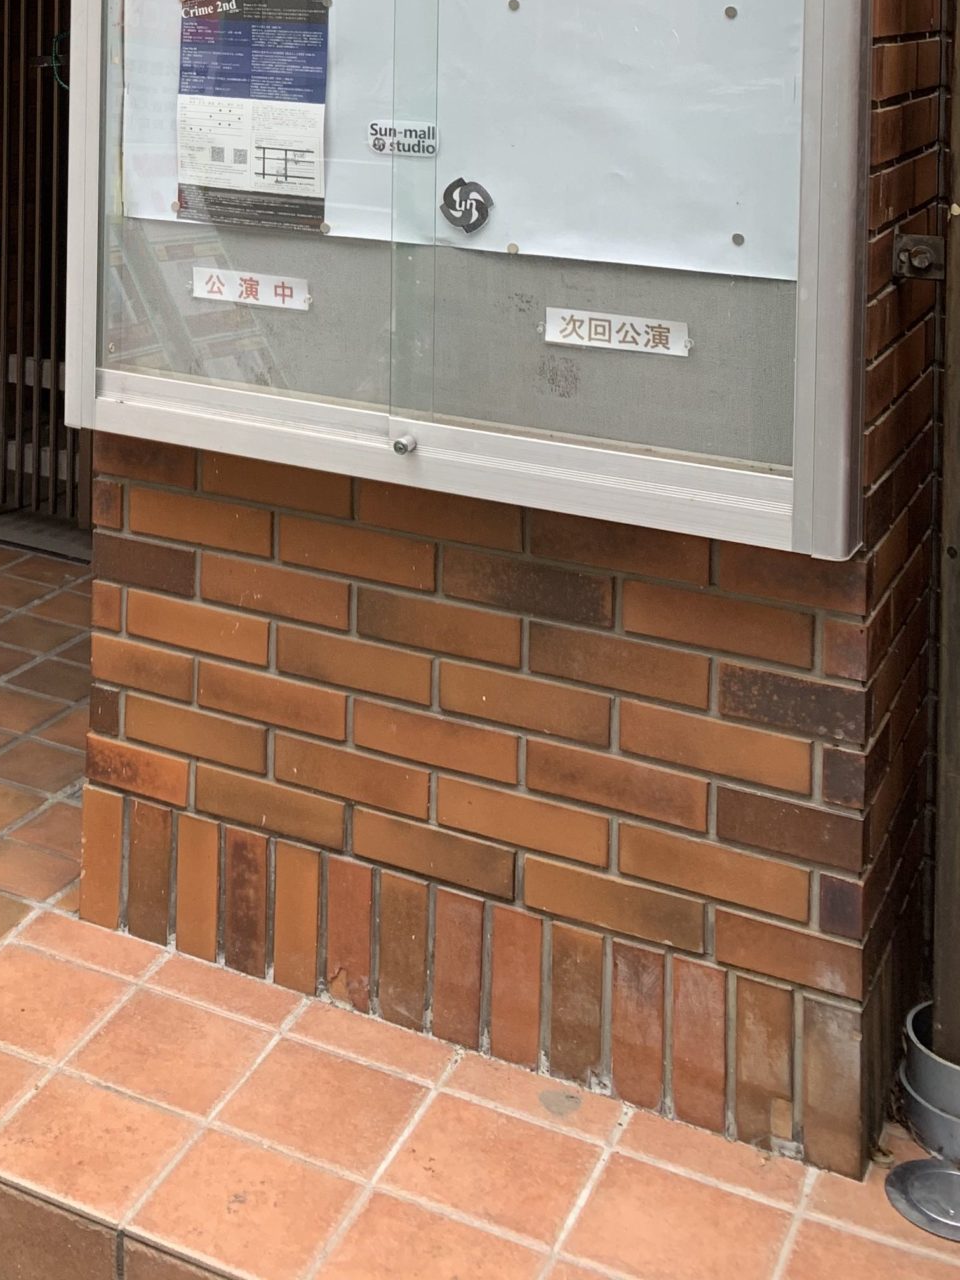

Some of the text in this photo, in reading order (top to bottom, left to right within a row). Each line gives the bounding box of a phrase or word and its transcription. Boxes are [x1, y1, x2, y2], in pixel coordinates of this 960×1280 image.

[181, 5, 214, 19] Crime
[370, 123, 436, 140] Sun-mall
[389, 141, 436, 155] studio
[205, 274, 294, 304] 公演中
[559, 314, 671, 350] 次回公演
